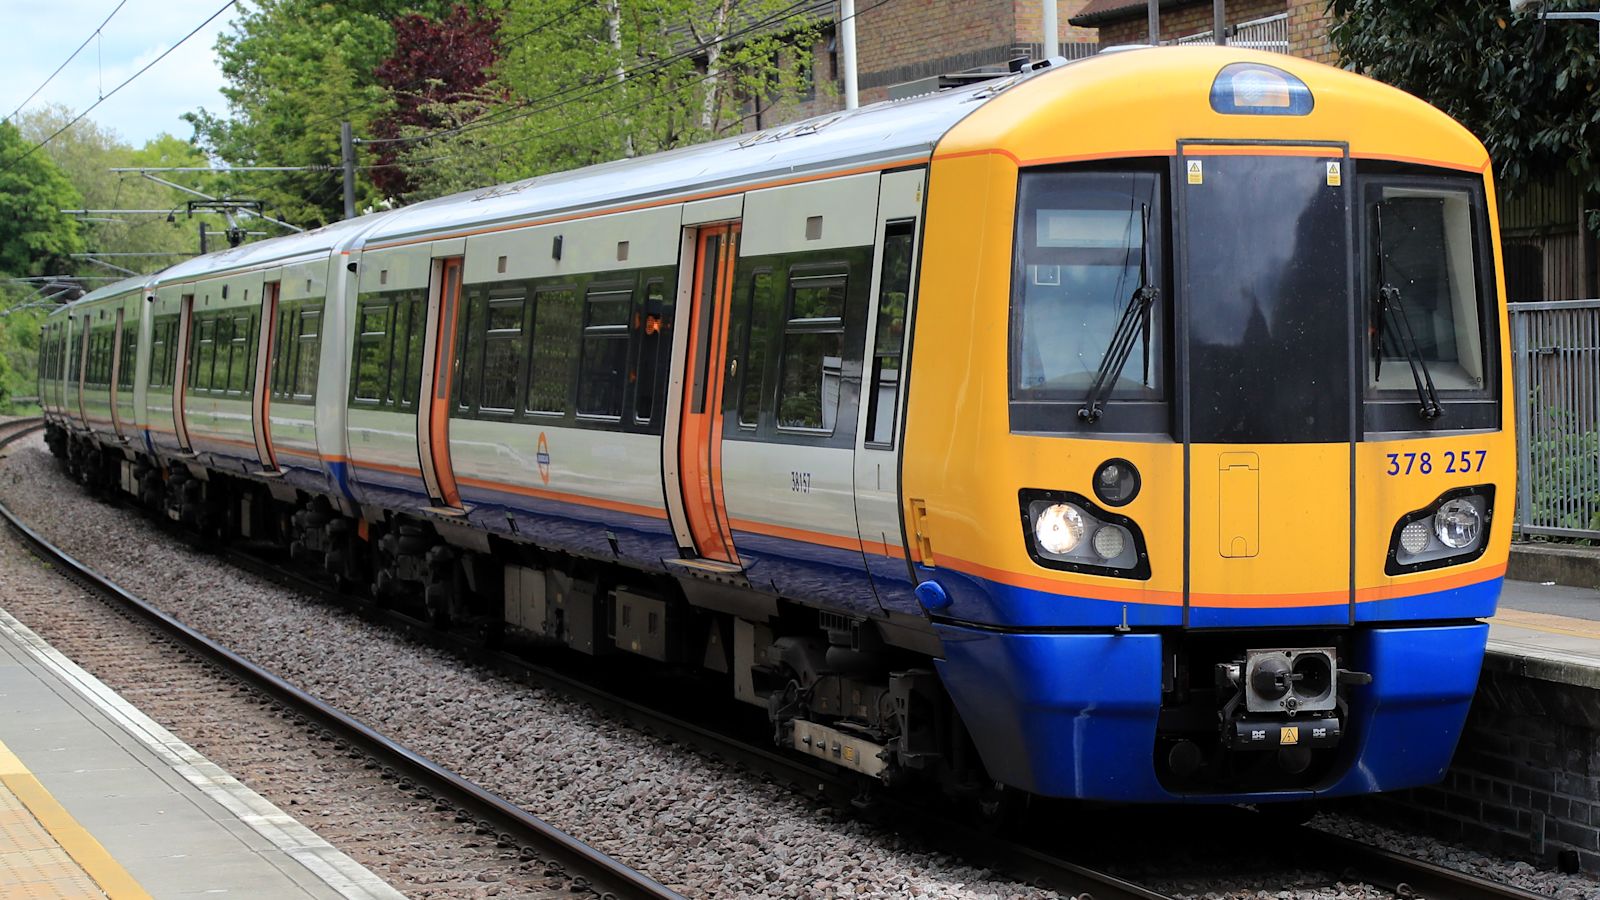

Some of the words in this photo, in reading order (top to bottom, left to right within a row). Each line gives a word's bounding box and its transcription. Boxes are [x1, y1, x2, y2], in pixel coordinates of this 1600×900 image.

[1386, 452, 1432, 476] 378
[1443, 450, 1487, 473] 257
[791, 471, 811, 494] 38157
